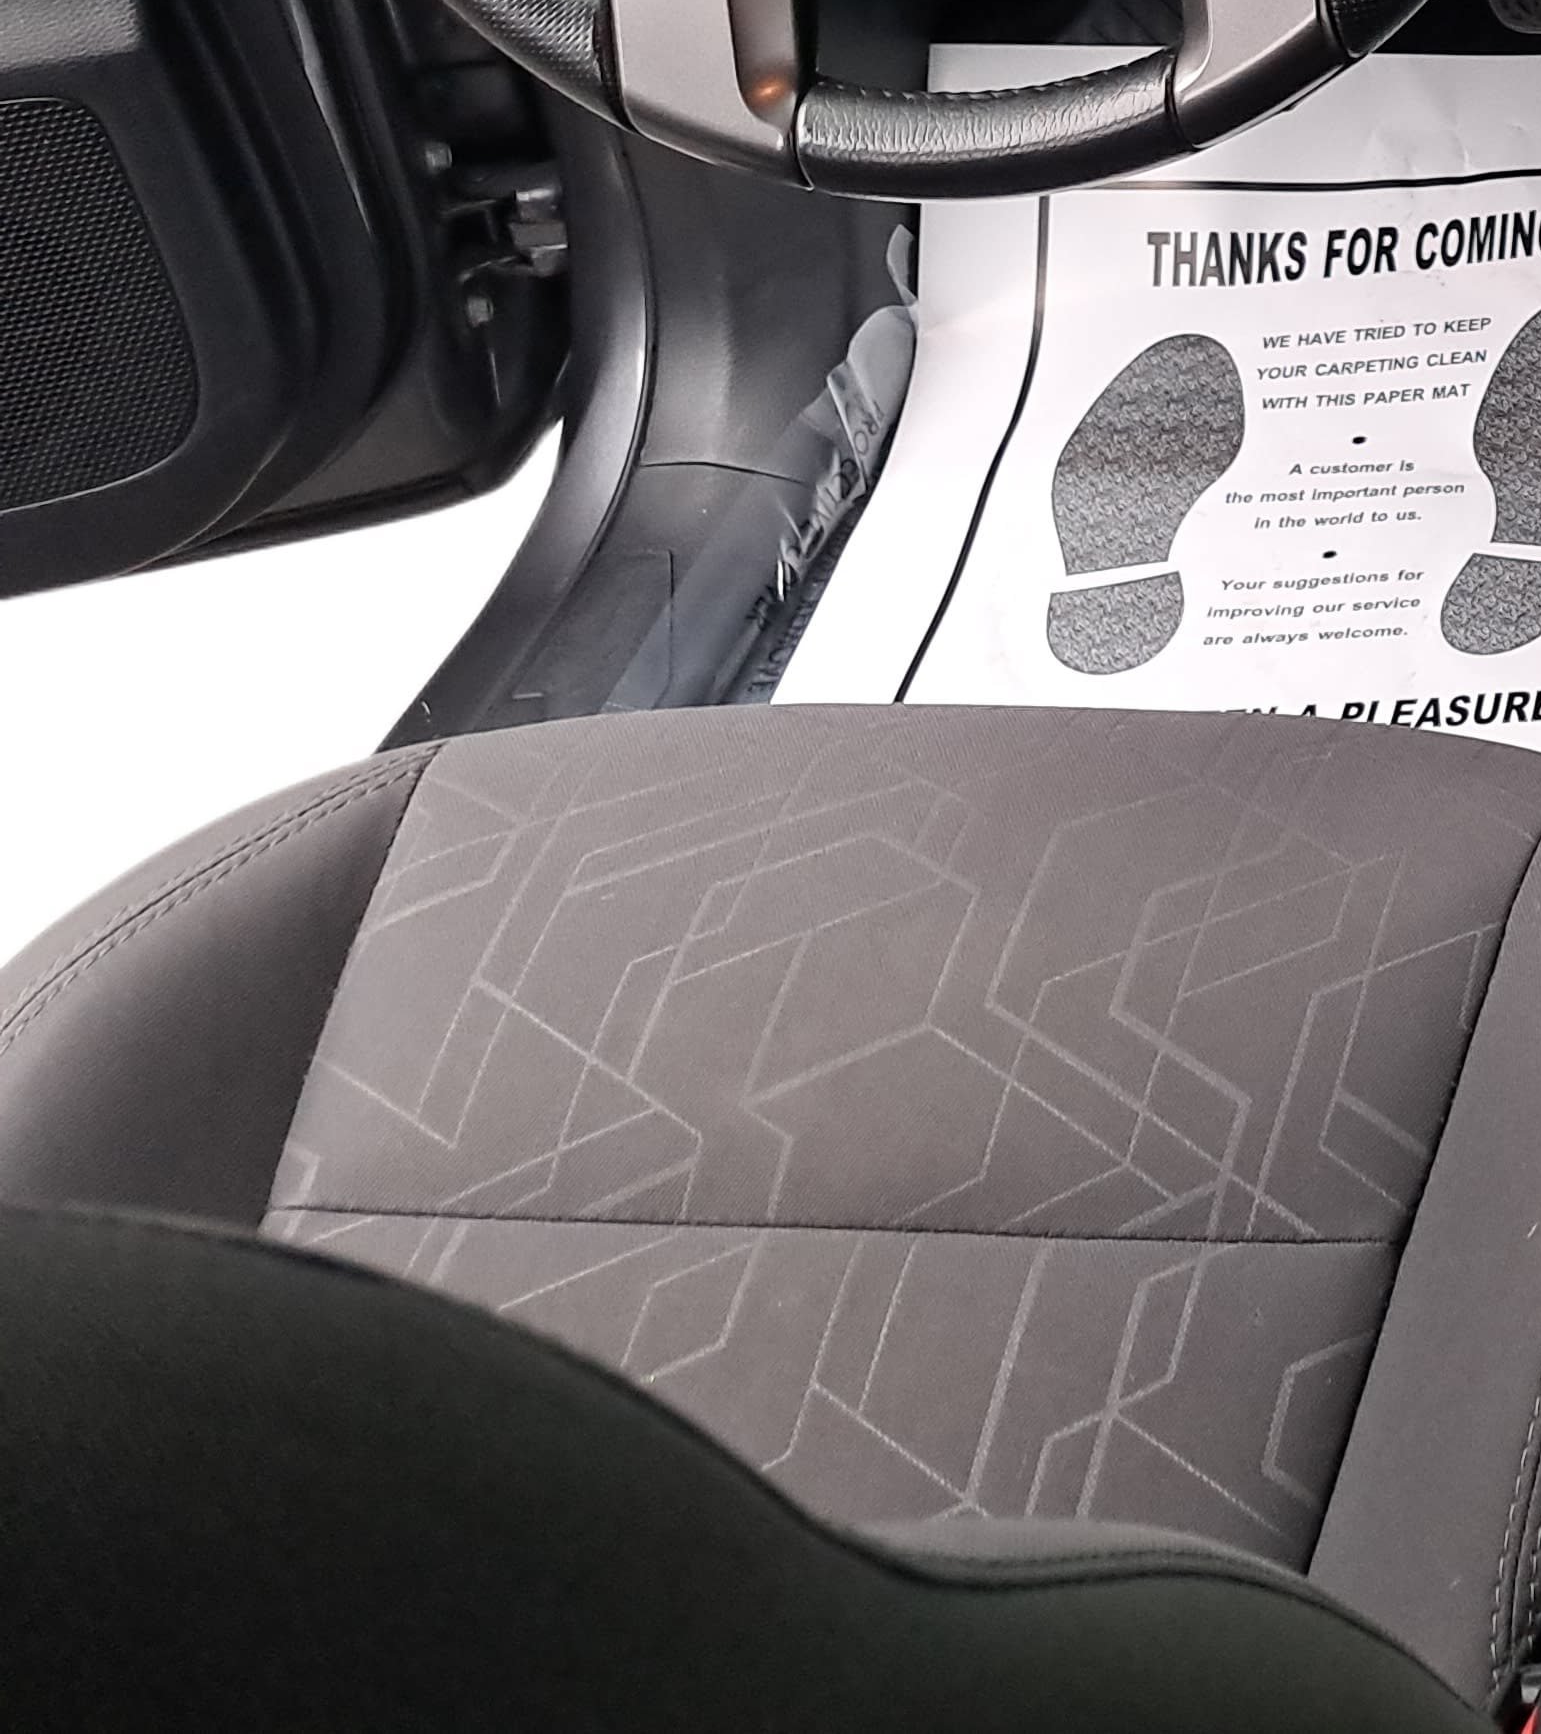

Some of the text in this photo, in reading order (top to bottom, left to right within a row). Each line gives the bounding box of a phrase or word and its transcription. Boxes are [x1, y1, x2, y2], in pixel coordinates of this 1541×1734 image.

[1147, 229, 1307, 287] THANKS
[1323, 226, 1399, 278] FOR
[1262, 317, 1491, 349] WE HAVE TRIED TO KEEP
[1257, 349, 1488, 381] YOUR CARPETING CLEAN
[1262, 383, 1471, 410] WITH THIS PAPER MAT
[1289, 460, 1415, 475] A customer is
[1225, 483, 1465, 504] the most important person
[1254, 510, 1422, 529] in the world to us.
[1221, 569, 1425, 591] Your suggestions for
[1206, 597, 1421, 620] improving our service
[1202, 626, 1408, 646] are always welcome.
